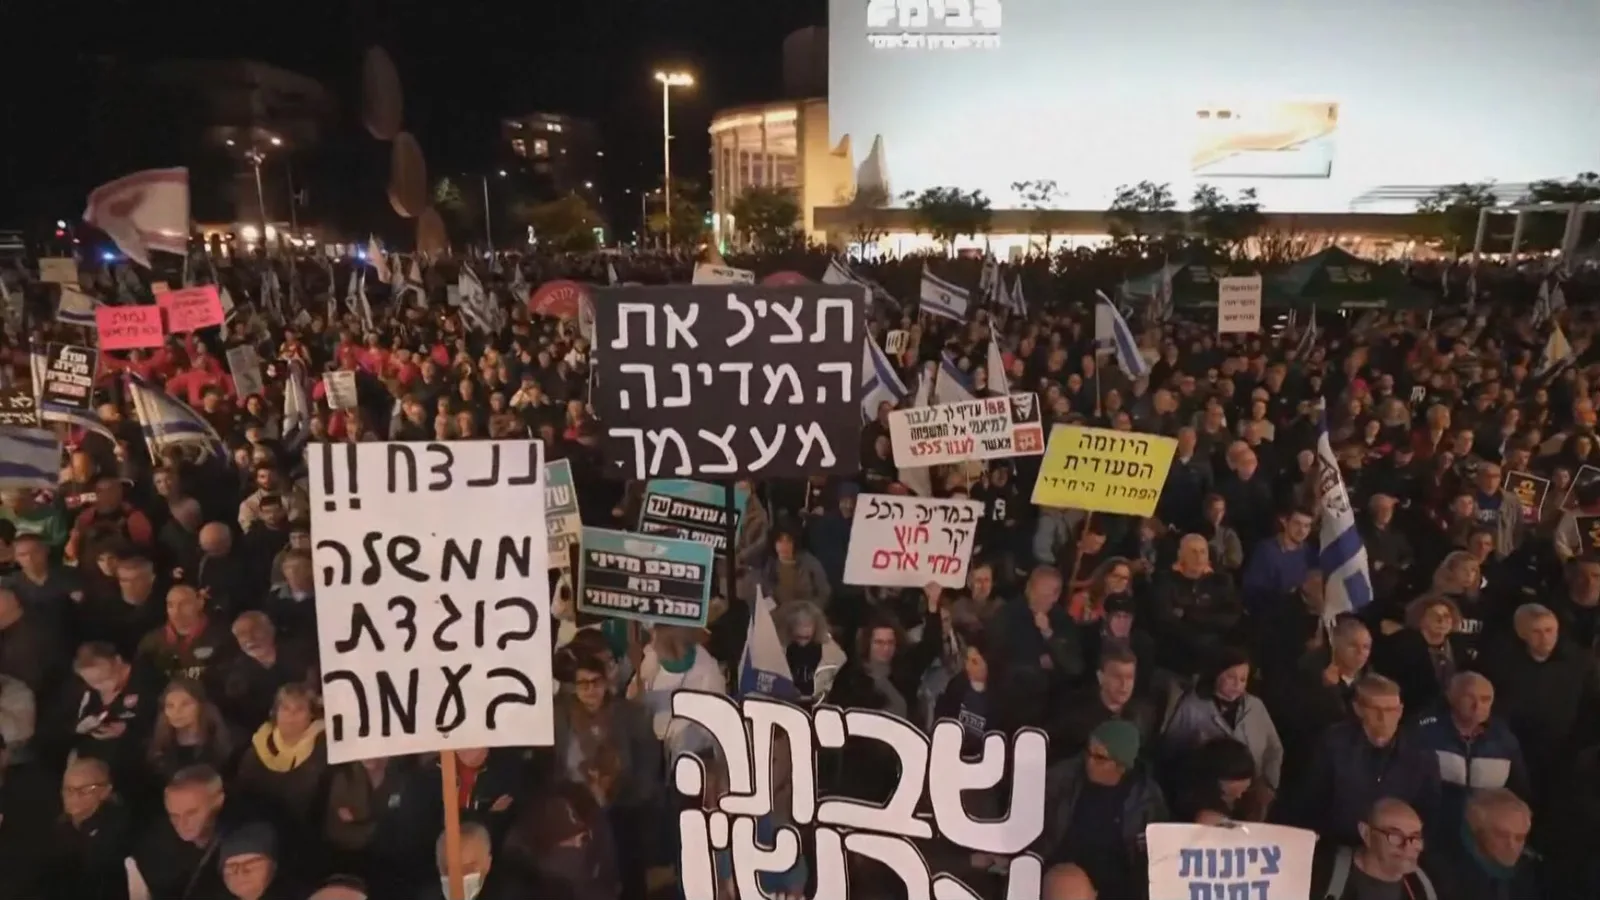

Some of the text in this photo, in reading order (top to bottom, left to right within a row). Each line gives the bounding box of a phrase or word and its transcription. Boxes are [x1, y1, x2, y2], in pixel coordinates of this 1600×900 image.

[611, 293, 853, 349] תציל את
[620, 362, 853, 410] המדינה
[952, 423, 967, 436] אל
[1078, 433, 1149, 456] היוזמה
[608, 421, 837, 480] מעצמך
[1063, 455, 1154, 480] הסעודית
[1043, 476, 1158, 500] הפתרון היחידי
[865, 498, 975, 526] במדינה הכל
[894, 525, 970, 556] יקר חוץ
[316, 531, 532, 587] ממשלה
[590, 551, 700, 581] הסכם מדיני
[872, 549, 919, 571] אדם
[627, 577, 661, 593] הוא
[585, 588, 701, 618] מהלך ביטחוני
[335, 594, 539, 653] בוגדת
[323, 663, 537, 741] בעמה
[672, 690, 1048, 854] שביתה
[1178, 845, 1282, 878] ציונות
